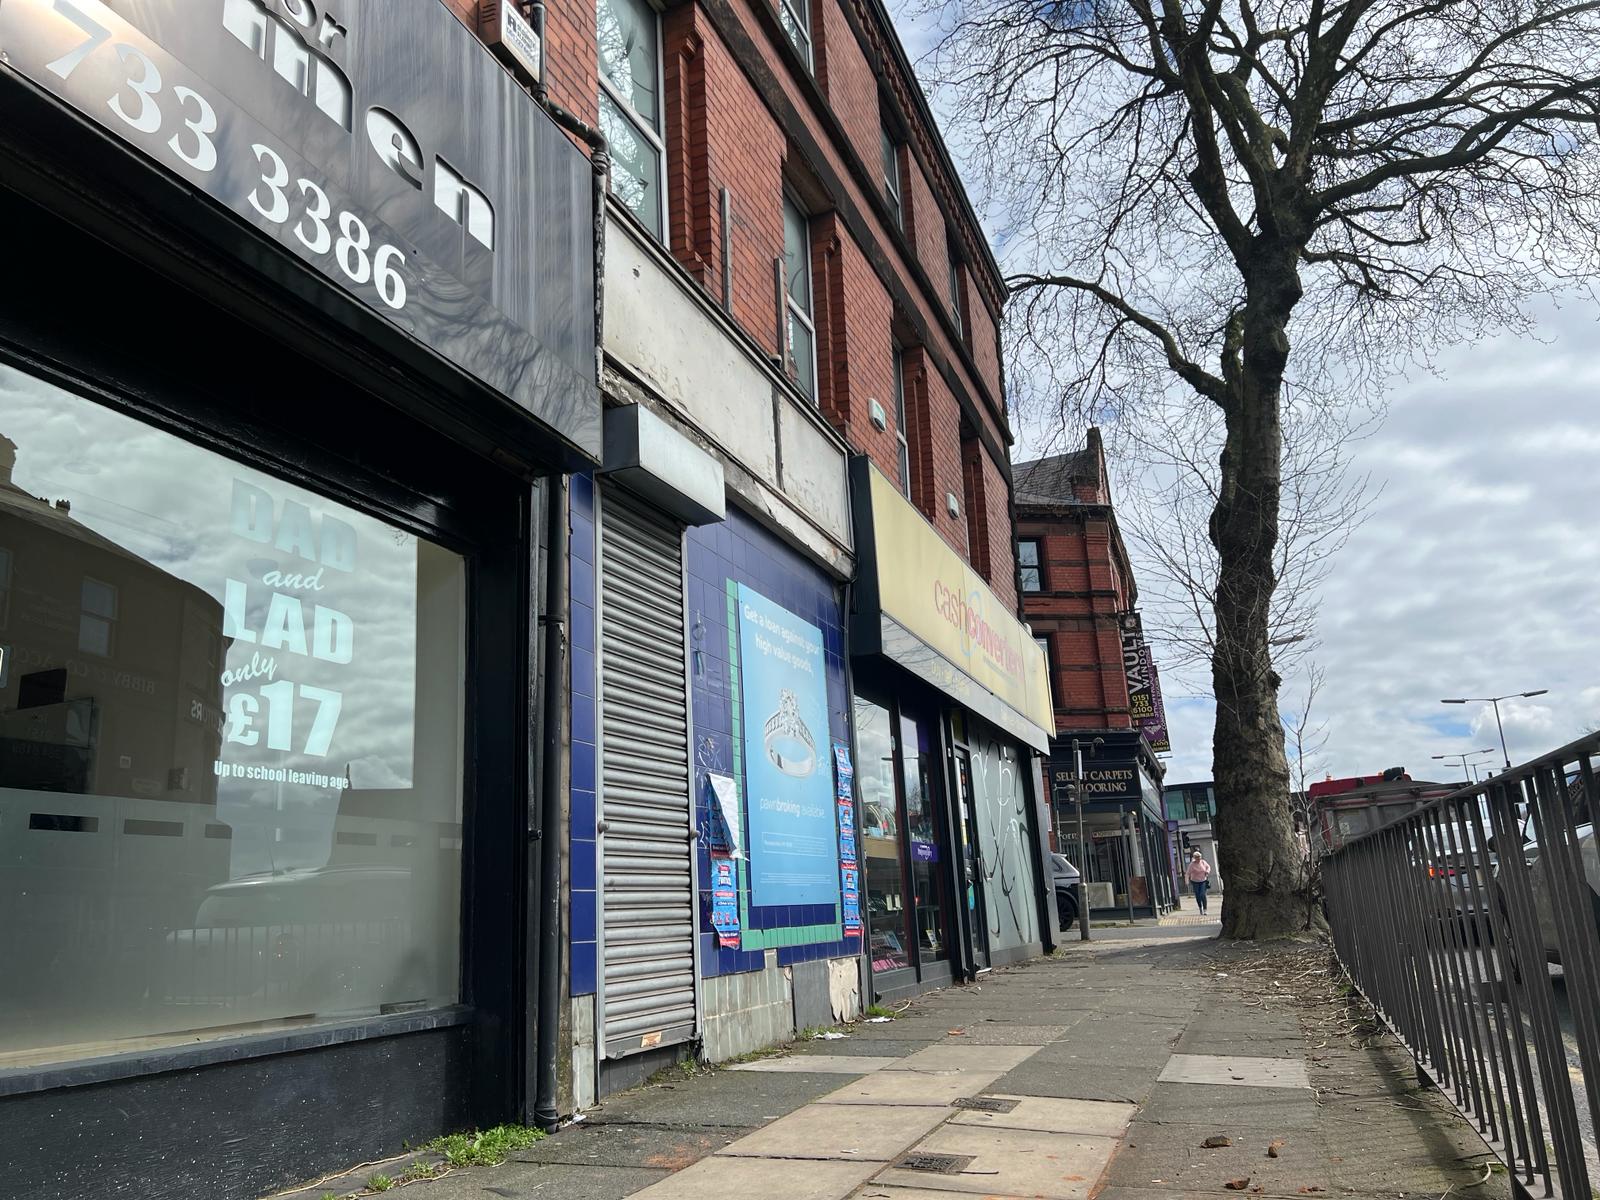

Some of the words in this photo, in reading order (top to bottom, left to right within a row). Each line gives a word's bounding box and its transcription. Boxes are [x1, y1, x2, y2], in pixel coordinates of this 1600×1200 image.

[46, 0, 218, 172] 733
[247, 143, 407, 310] 3386
[222, 0, 495, 253] men
[231, 477, 358, 573] DAD
[262, 567, 325, 592] and
[222, 578, 354, 665] LAD
[220, 651, 278, 687] only
[1120, 629, 1144, 695] VAULT
[1135, 632, 1151, 689] WINDOWS
[227, 679, 343, 758] £17
[1131, 694, 1150, 702] 0151
[1132, 706, 1153, 714] 6100
[214, 760, 230, 778] Up
[232, 763, 246, 778] to
[247, 766, 287, 782] school
[288, 769, 328, 788] leaving
[329, 776, 349, 789] age
[1055, 771, 1089, 782] SELET
[1090, 769, 1133, 781] CARPETS
